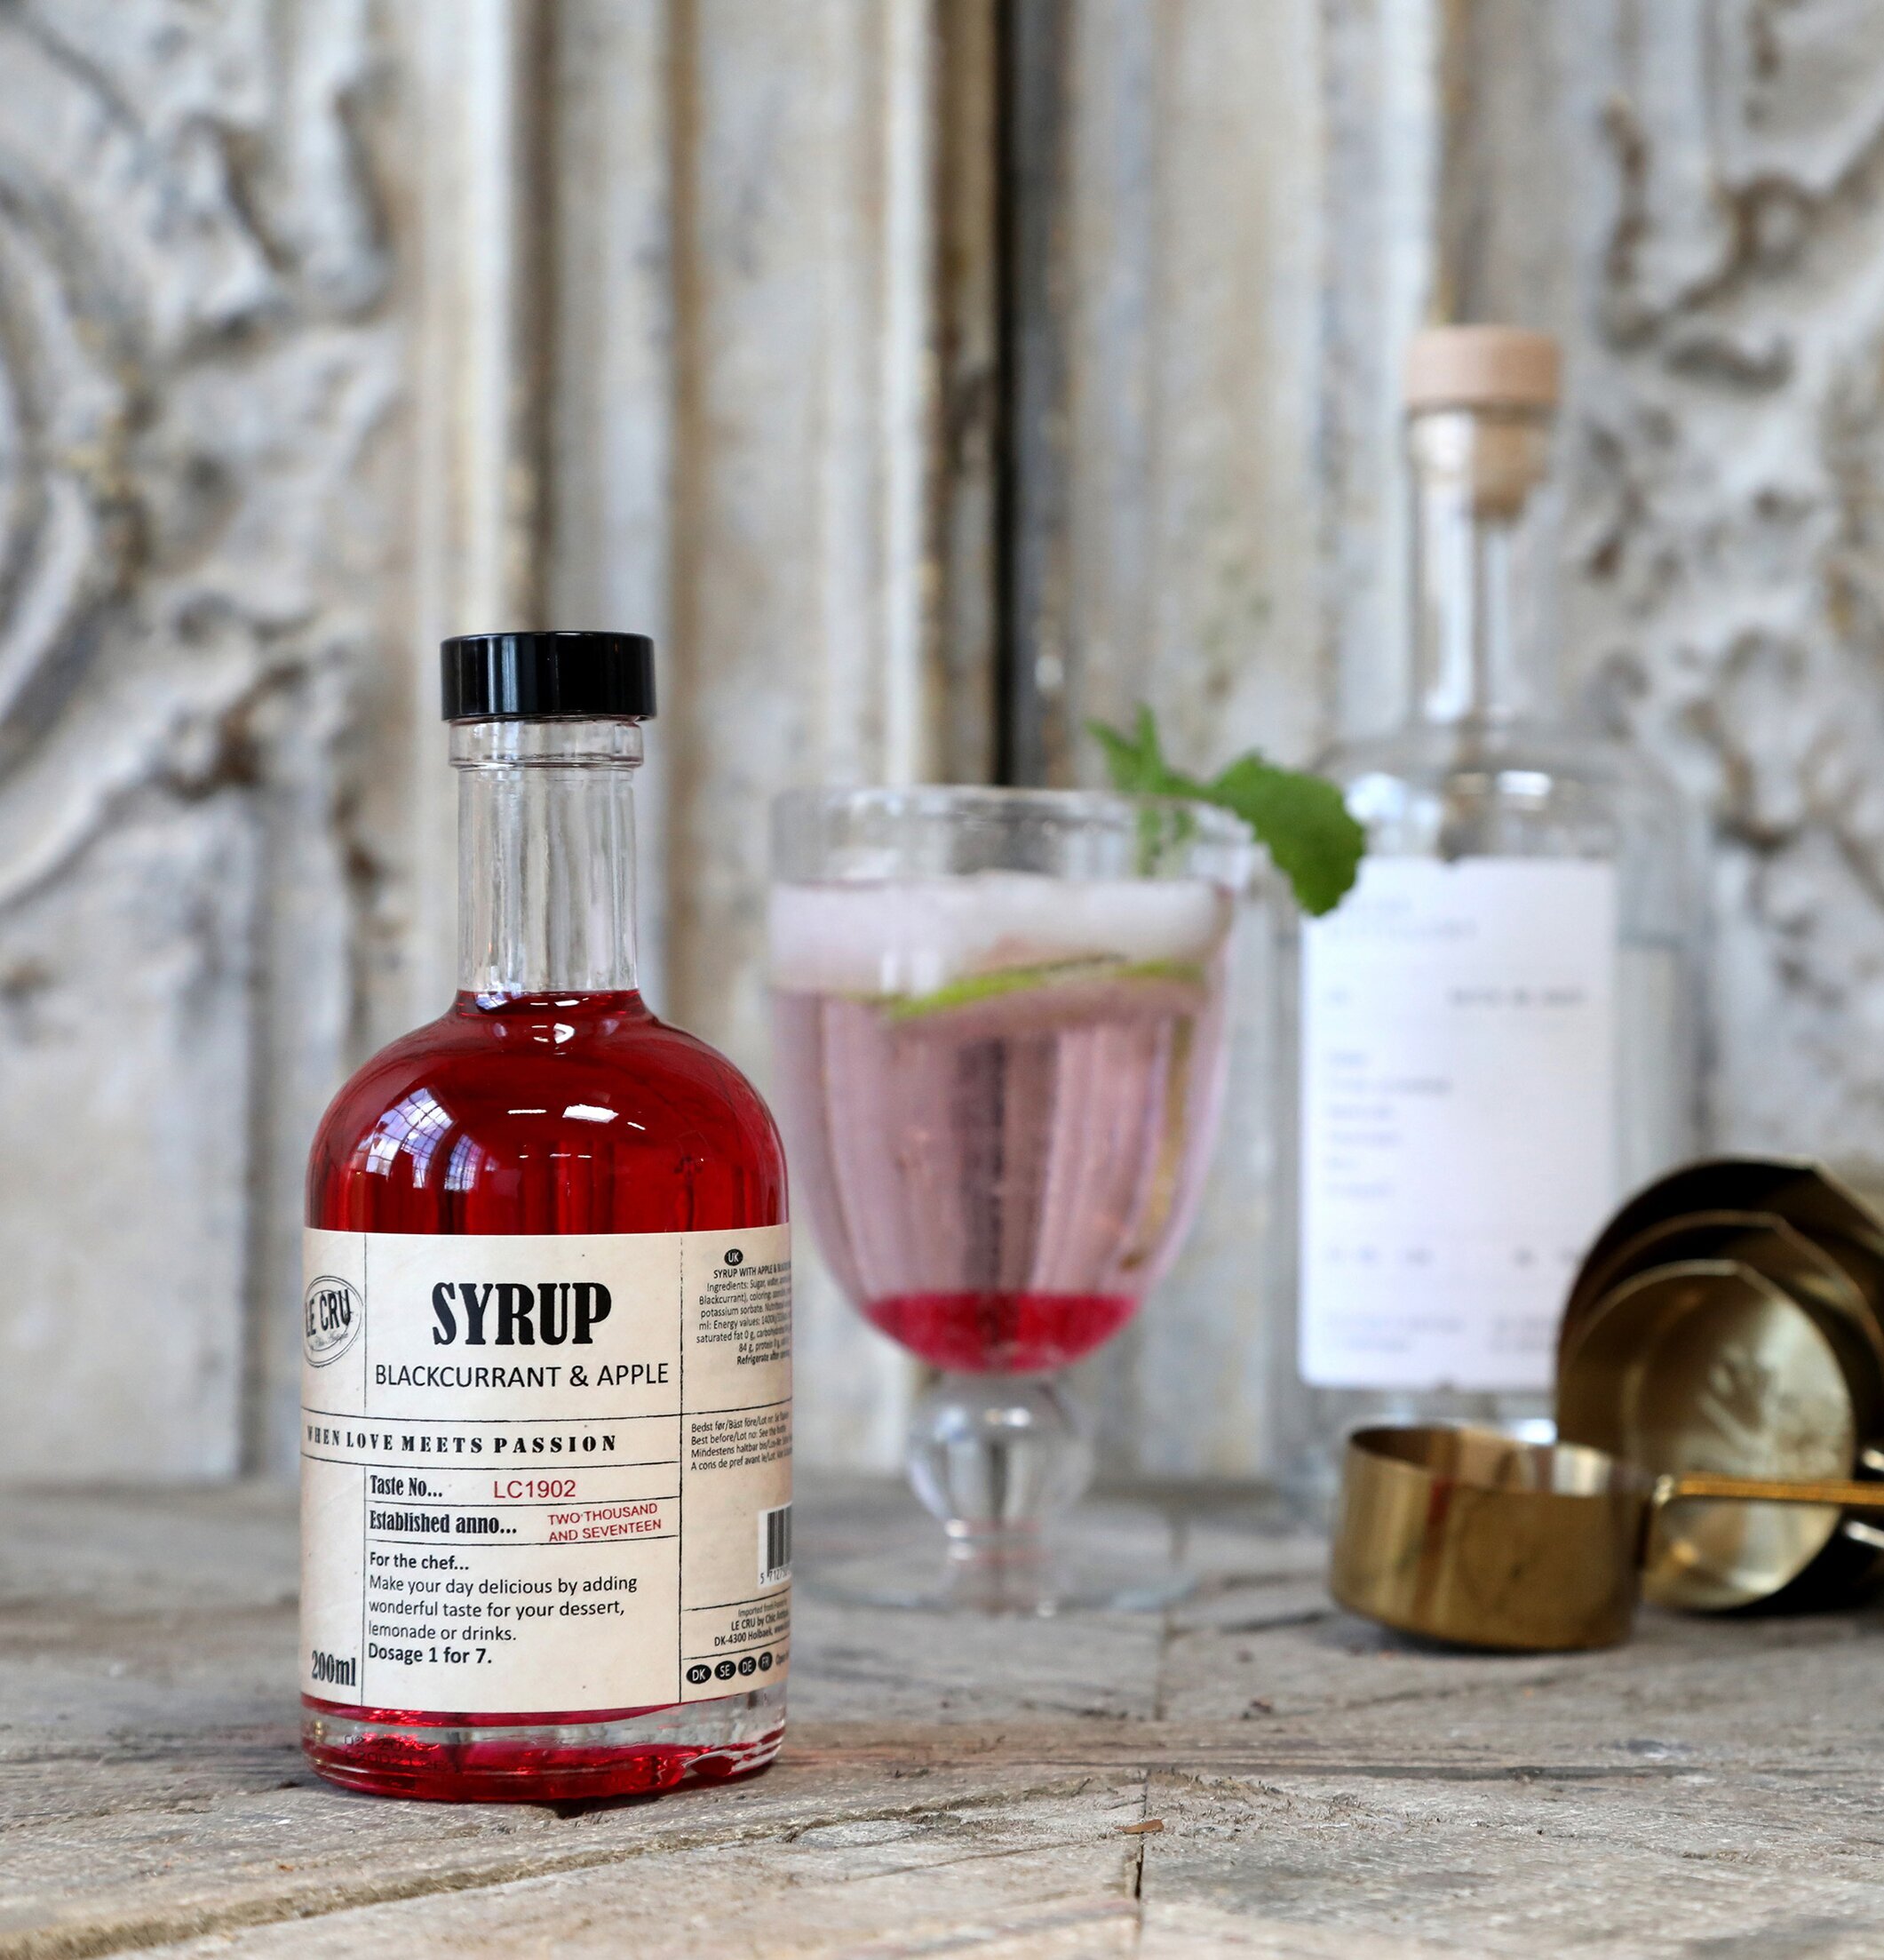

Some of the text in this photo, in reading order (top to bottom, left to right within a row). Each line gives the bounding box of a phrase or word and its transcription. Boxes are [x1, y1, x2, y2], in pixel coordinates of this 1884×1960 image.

[728, 1251, 739, 1263] UK
[713, 1269, 738, 1279] SYRUP
[739, 1266, 757, 1278] WITH
[757, 1264, 774, 1276] APPLE
[706, 1280, 749, 1294] Ingredients:
[320, 1289, 352, 1331] CRU
[432, 1282, 612, 1345] SYRUP
[700, 1306, 739, 1319] potassium
[699, 1321, 711, 1331] ml:
[713, 1319, 739, 1331] Energy
[739, 1318, 760, 1327] values:
[696, 1332, 733, 1343] saturated
[734, 1331, 743, 1341] fat
[738, 1343, 747, 1352] 84
[736, 1353, 769, 1366] Refrigerate
[376, 1363, 669, 1388] BLACKCURRANT & APPLE
[691, 1422, 713, 1433] Bedst
[346, 1431, 393, 1451] LOVE
[401, 1435, 483, 1454] MEETS
[494, 1434, 616, 1454] PASSION
[691, 1436, 709, 1446] Best
[759, 1429, 768, 1438] See
[691, 1446, 735, 1458] Mindestens
[736, 1443, 759, 1454] haltbar
[691, 1461, 697, 1471] A
[698, 1461, 717, 1470] cons
[718, 1458, 728, 1469] de
[728, 1455, 743, 1469] pref
[744, 1454, 760, 1465] avant
[370, 1475, 443, 1498] Taste No...
[494, 1479, 576, 1499] LC1902
[370, 1510, 517, 1534] Established anno...
[547, 1502, 658, 1526] TWO THOUSAND
[549, 1518, 662, 1543] AND SEVENTEEN
[370, 1551, 470, 1571] For the chef...
[370, 1574, 638, 1597] Make your day delicious by adding
[760, 1572, 765, 1585] 5
[369, 1599, 625, 1621] wonderful taste for your dessert,
[738, 1605, 763, 1618] Imported
[369, 1621, 517, 1642] lemonade or drinks.
[731, 1621, 740, 1631] LE
[741, 1617, 756, 1629] CRU
[757, 1616, 764, 1628] by
[714, 1632, 747, 1646] DK-4300
[369, 1643, 493, 1664] Dosage 1 for 7.
[312, 1650, 356, 1687] 200ml
[692, 1668, 707, 1681] DK
[719, 1664, 730, 1677] SE
[742, 1660, 752, 1674] DE
